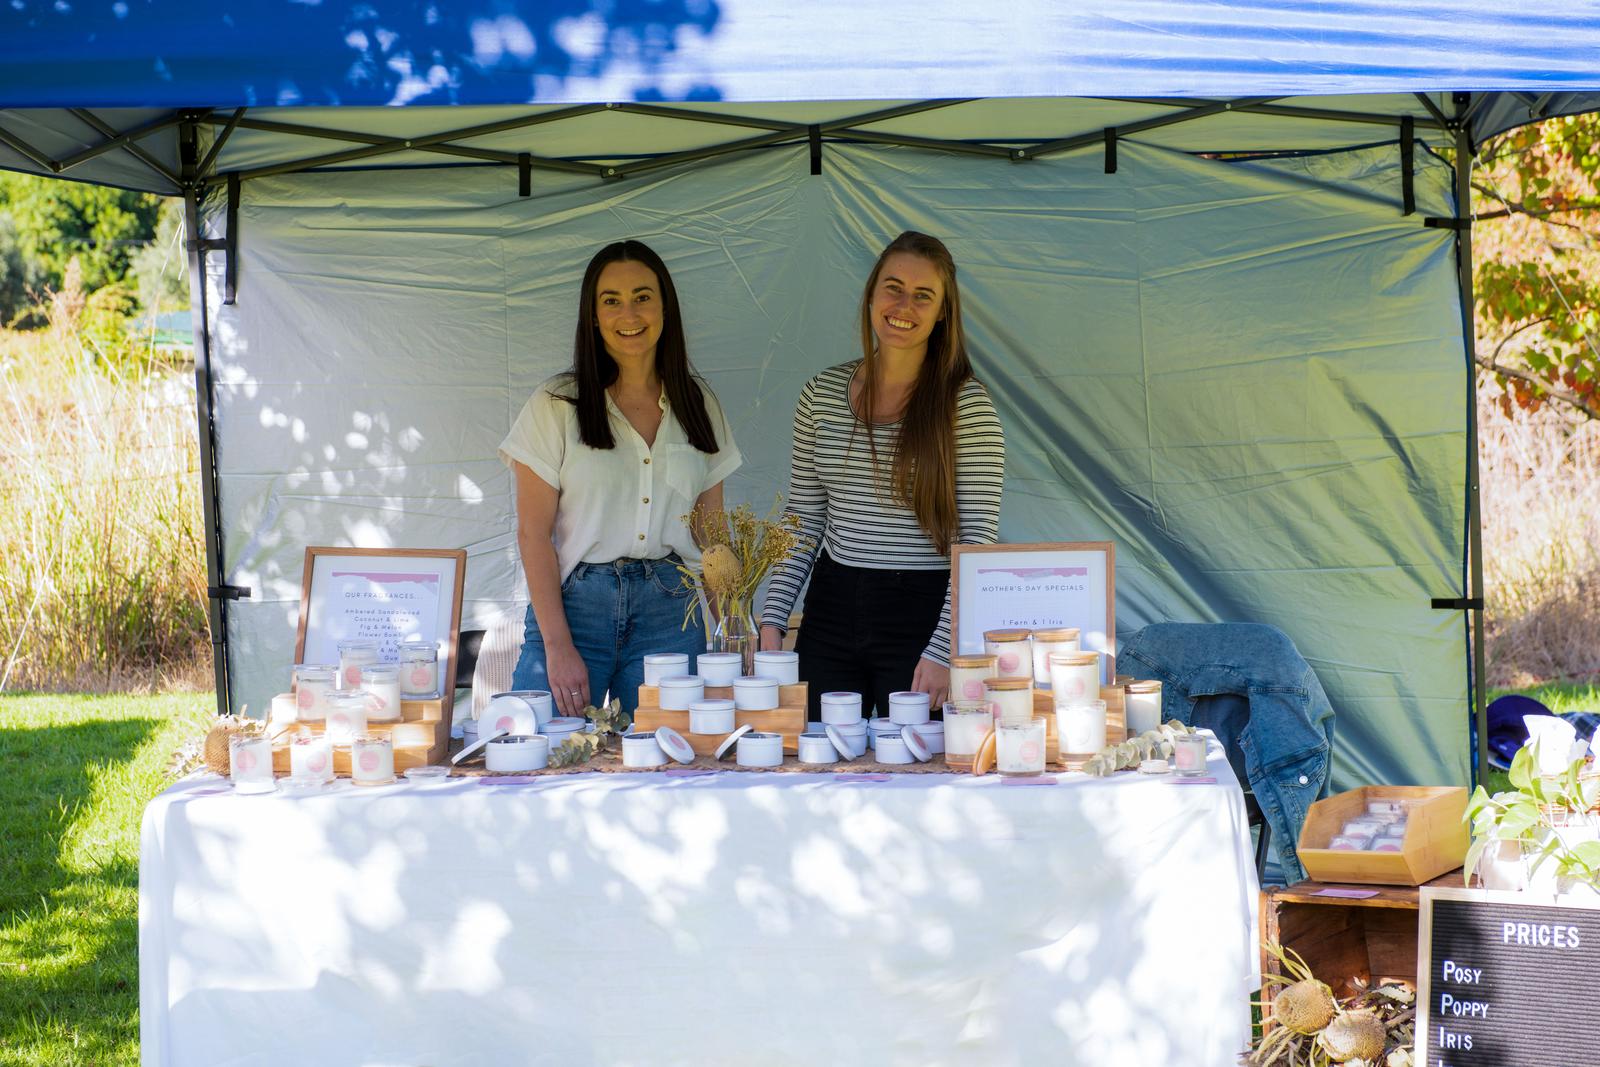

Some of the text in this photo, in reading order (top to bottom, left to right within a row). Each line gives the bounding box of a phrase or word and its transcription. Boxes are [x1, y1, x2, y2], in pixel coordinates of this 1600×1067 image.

[982, 584, 1085, 592] MOTHER'S DAY SPECIALS
[1503, 922, 1580, 948] PRICES
